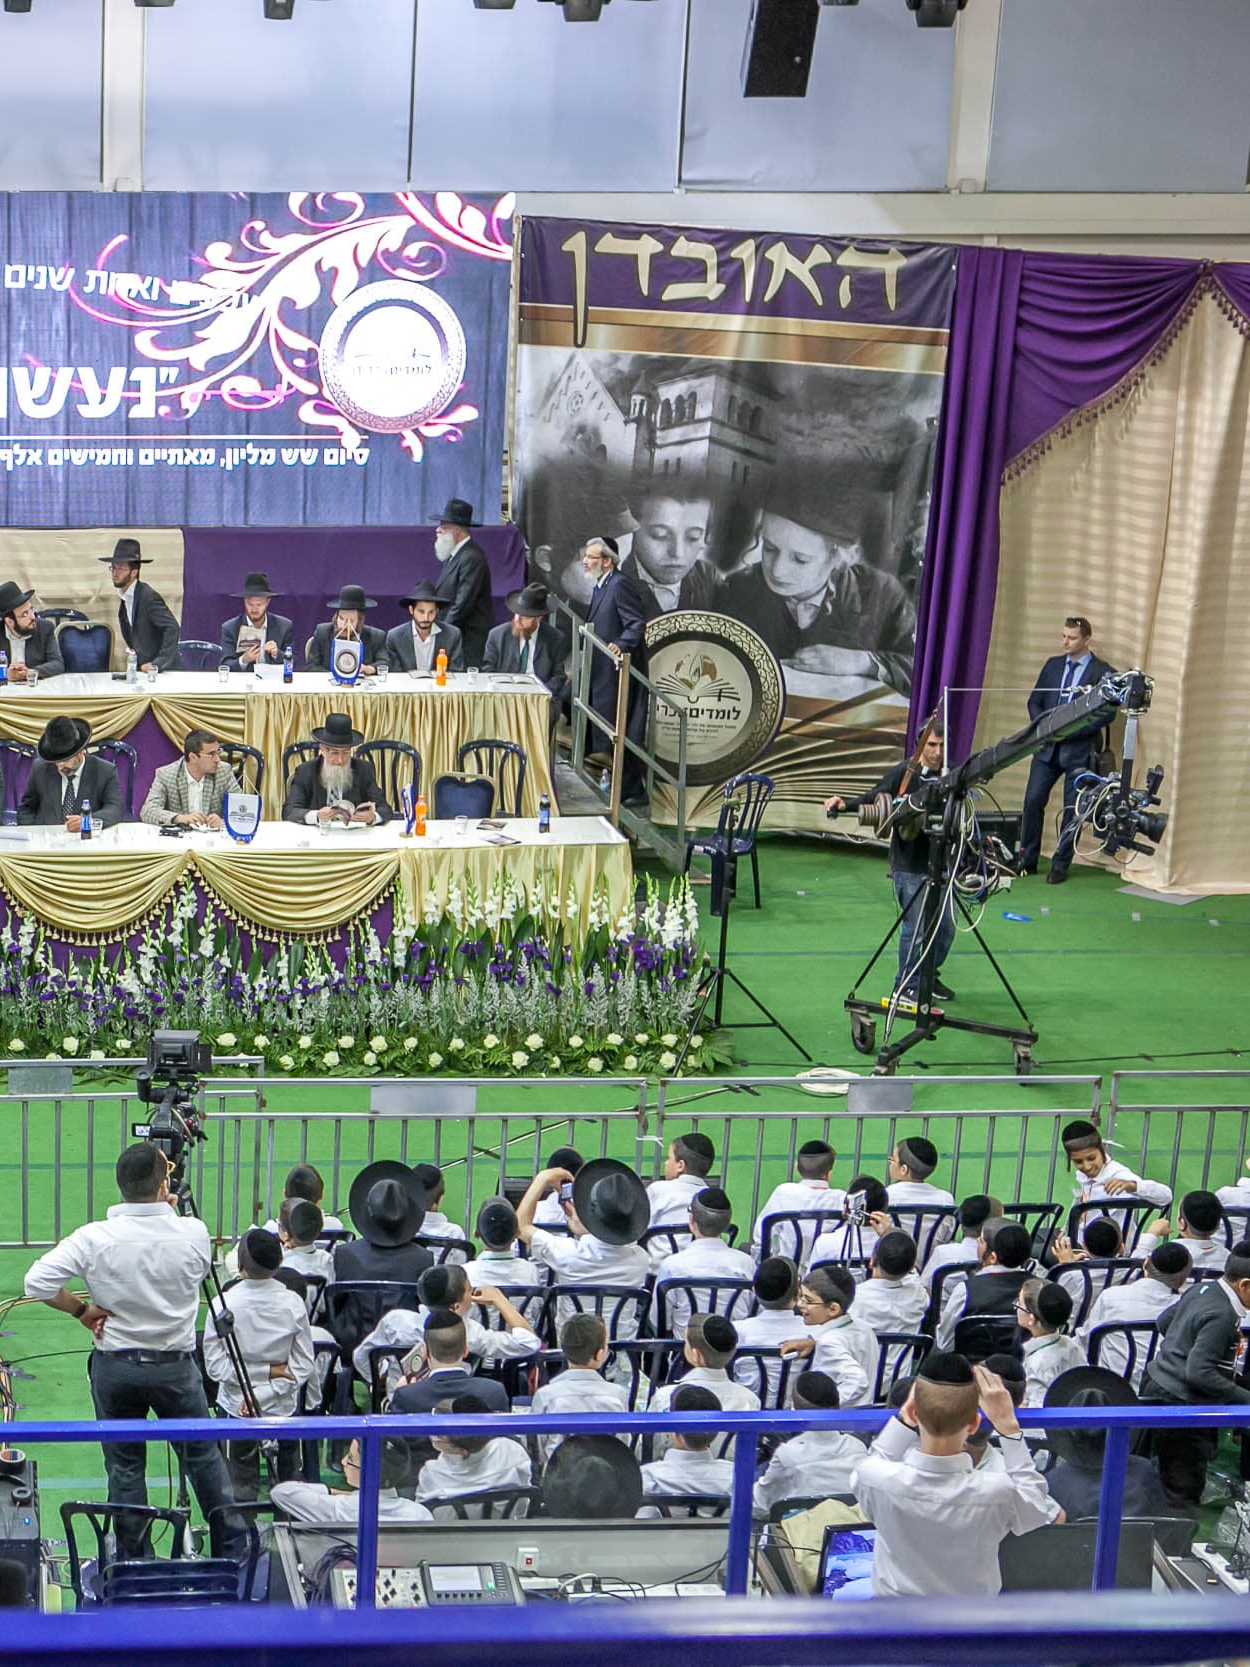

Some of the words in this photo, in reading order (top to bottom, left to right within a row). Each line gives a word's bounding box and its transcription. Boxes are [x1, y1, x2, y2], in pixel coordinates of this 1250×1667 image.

[4, 263, 75, 292] שנים
[561, 230, 908, 348] האובדן
[47, 448, 134, 466] וחמישים
[138, 447, 216, 466] מאתיים
[219, 442, 276, 470] מליון,
[280, 448, 319, 465] שש
[323, 447, 370, 465] סיום
